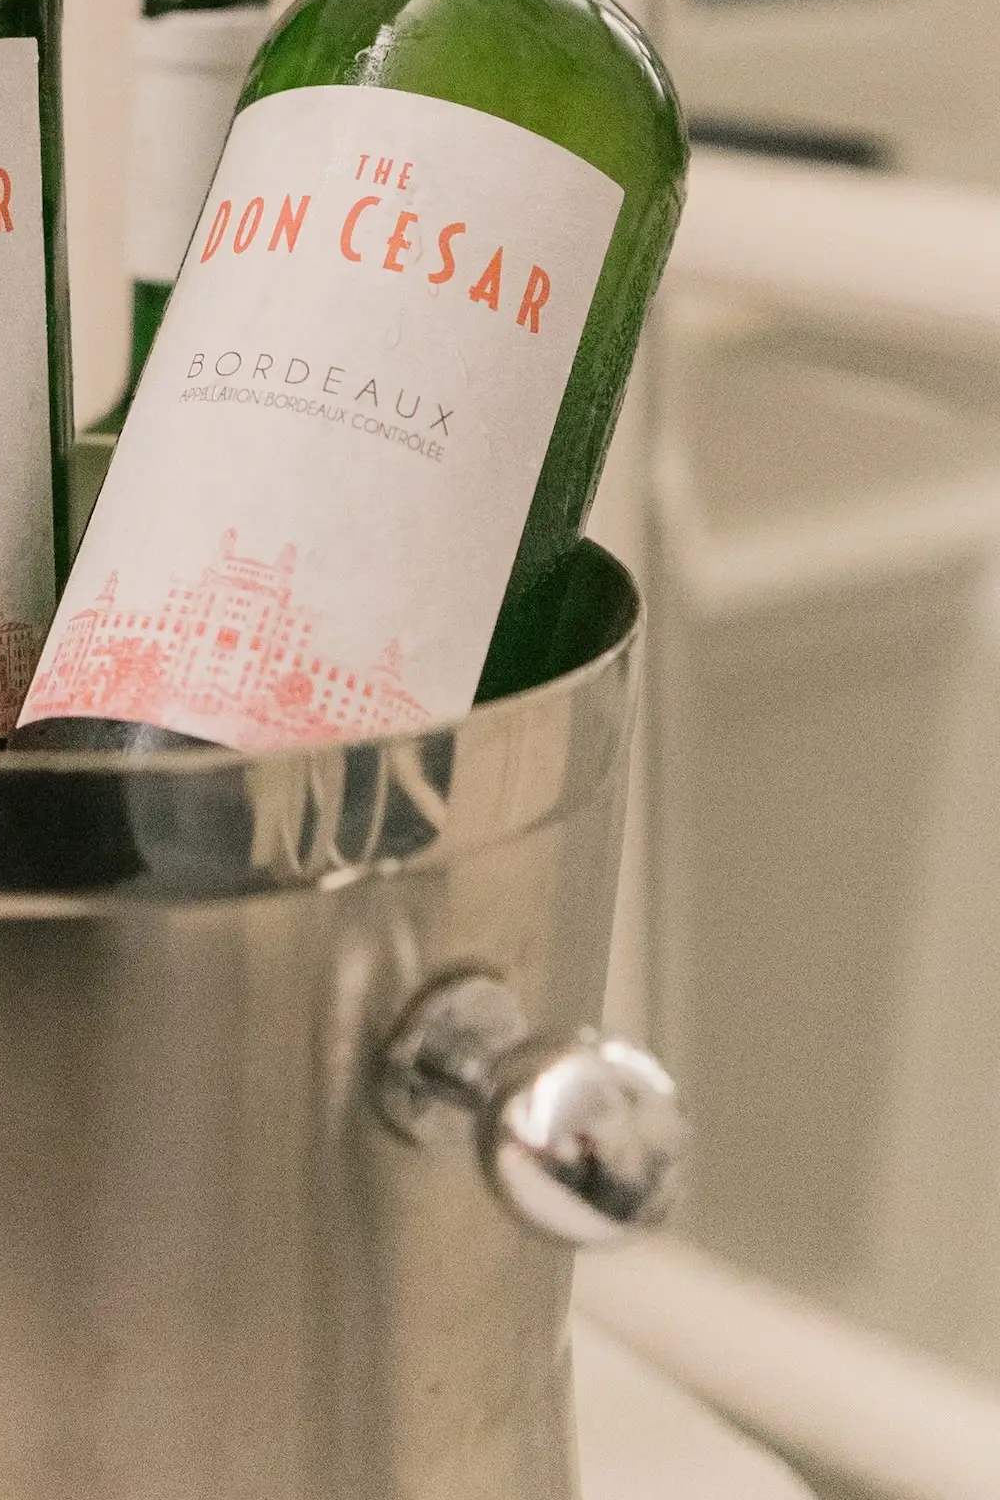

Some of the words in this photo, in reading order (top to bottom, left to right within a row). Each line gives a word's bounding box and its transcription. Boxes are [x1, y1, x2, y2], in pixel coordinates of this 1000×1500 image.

[355, 153, 414, 190] THE
[200, 194, 312, 263] DON
[340, 195, 552, 335] CESAR
[178, 383, 264, 405] APPELLATION
[263, 390, 347, 425] BORDEAUX
[351, 413, 446, 464] CONTRÔLÉE
[186, 350, 455, 437] BORDEAUX
